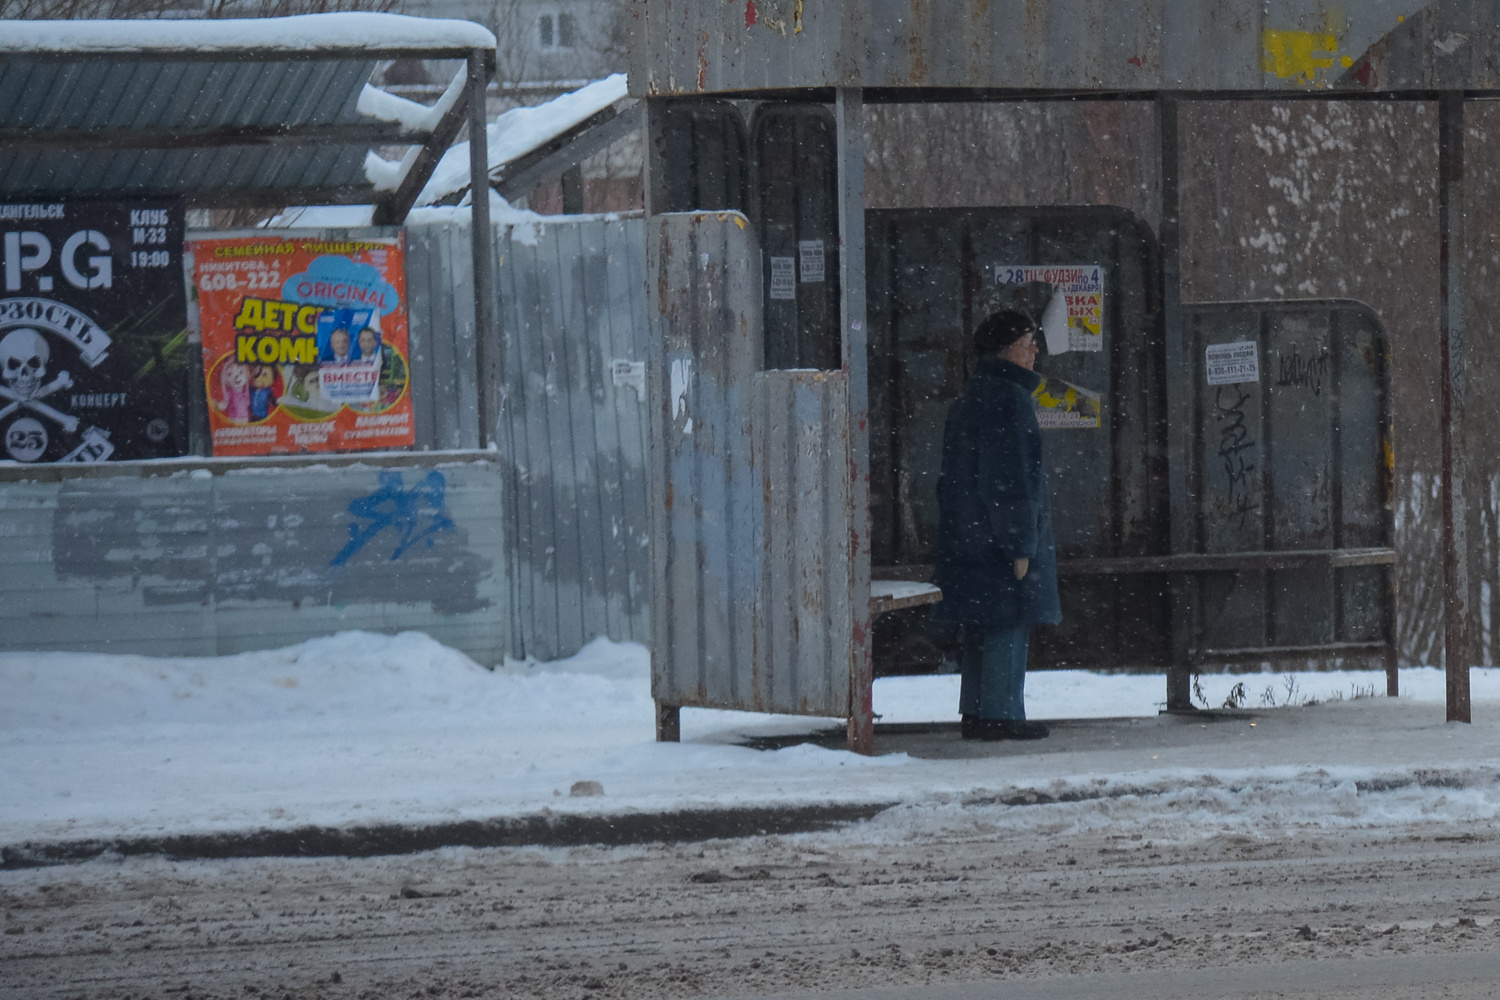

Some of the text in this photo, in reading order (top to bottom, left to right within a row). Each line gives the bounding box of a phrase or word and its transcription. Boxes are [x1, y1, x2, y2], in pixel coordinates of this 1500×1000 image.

[130, 209, 169, 226] КЛУБ
[130, 251, 170, 268] 19:00
[200, 271, 280, 292] 608-222
[1006, 269, 1024, 284] 28
[1091, 269, 1099, 284] 4
[297, 281, 388, 310] ORIGINAL
[236, 299, 323, 333] ДЕТС
[71, 393, 127, 408] КОНЦЕРТ
[10, 431, 43, 449] 25
